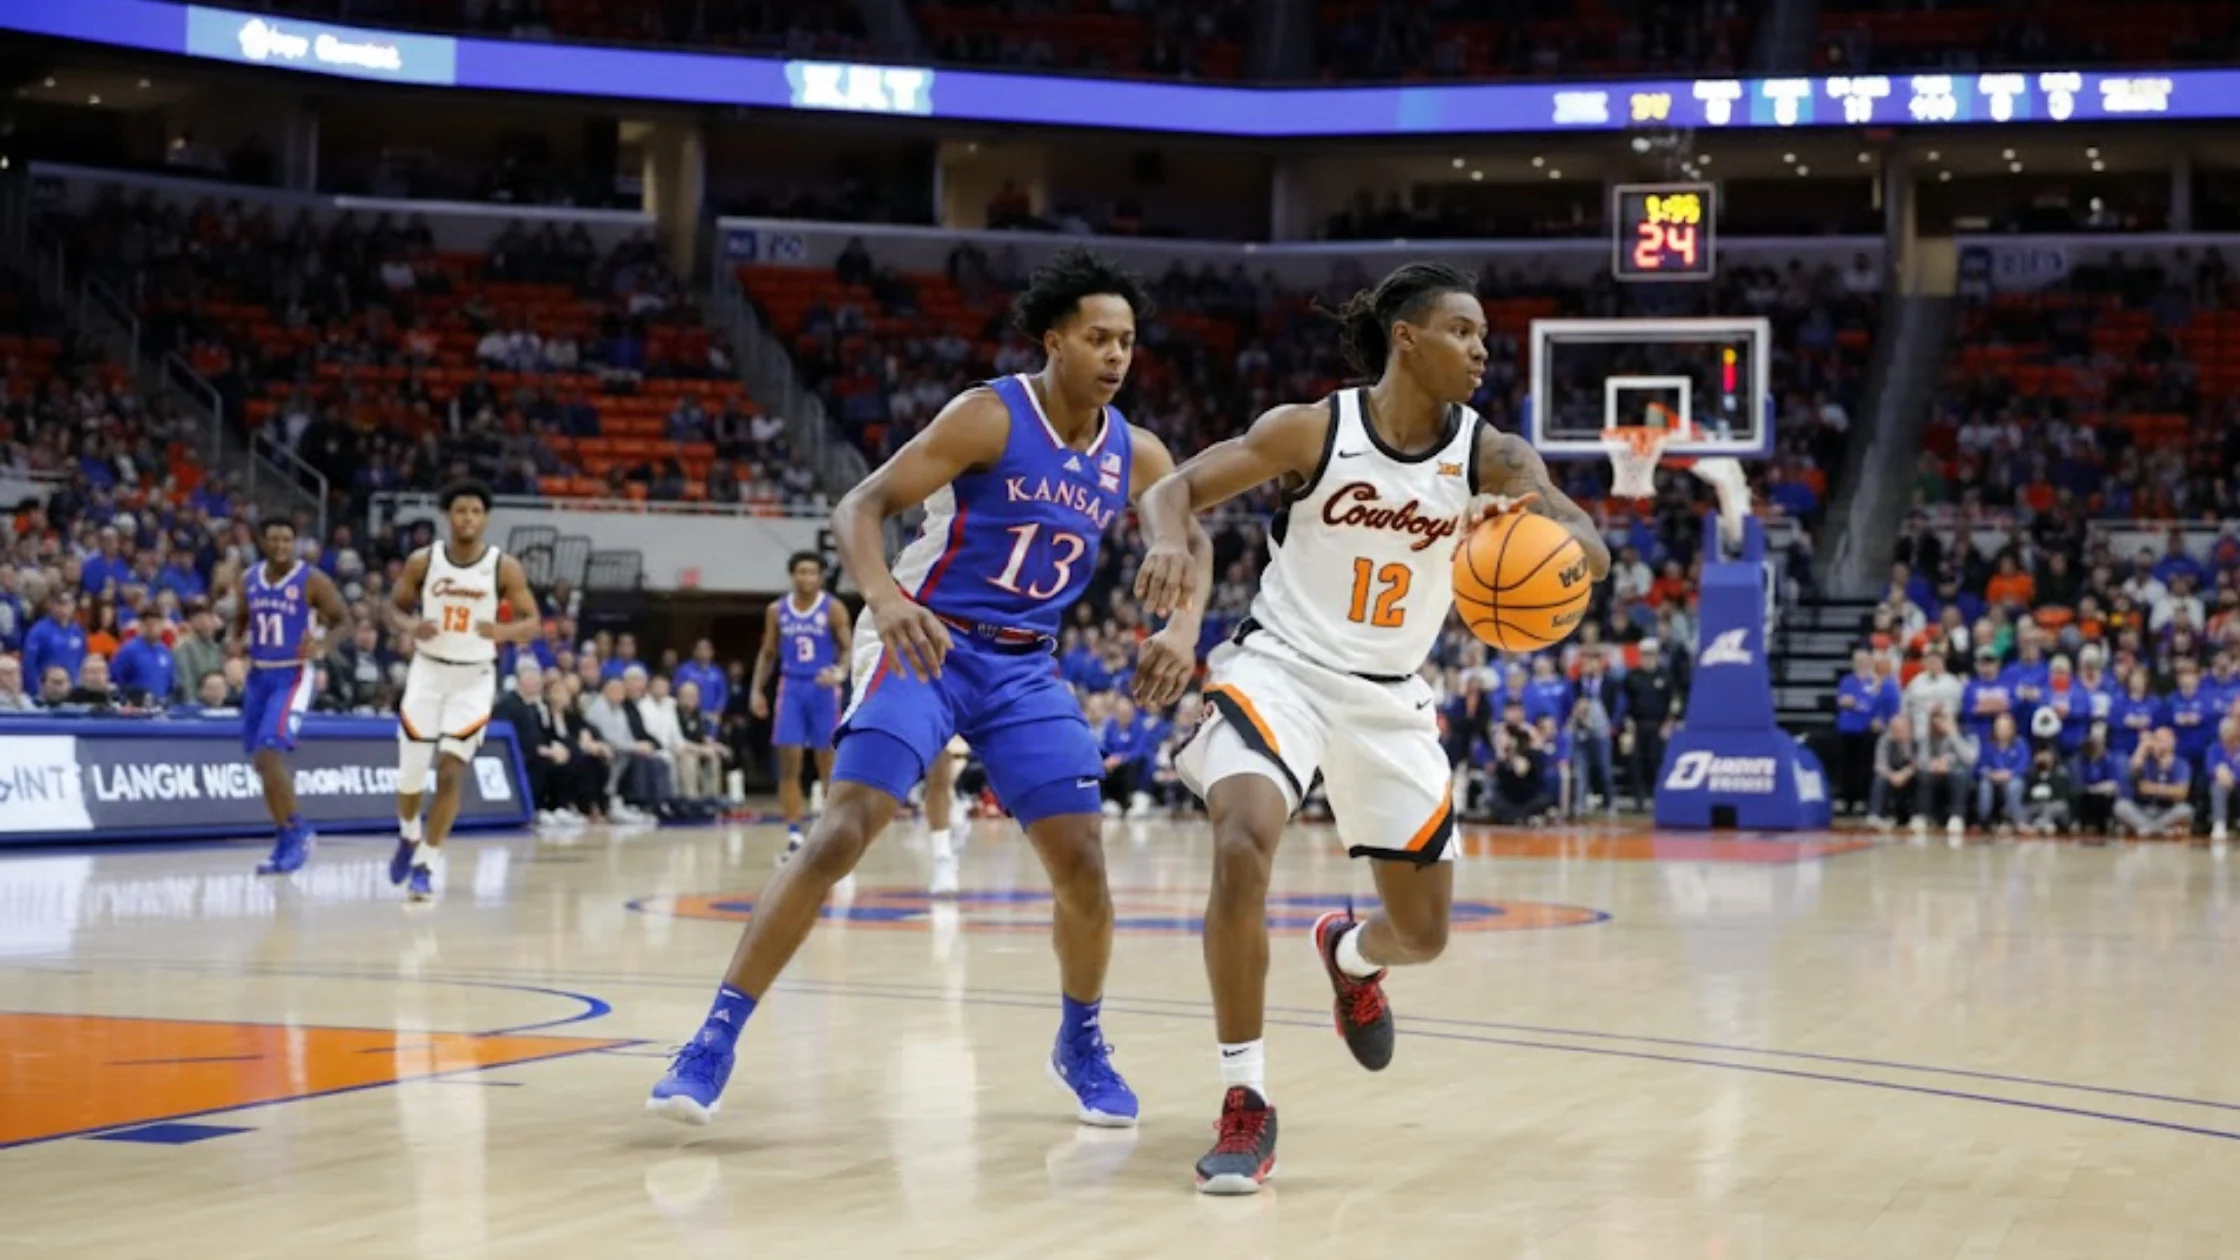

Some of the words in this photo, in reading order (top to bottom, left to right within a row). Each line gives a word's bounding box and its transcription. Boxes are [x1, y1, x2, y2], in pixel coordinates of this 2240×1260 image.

[1634, 222, 1696, 268] 24
[1005, 476, 1116, 530] KANSAS
[1322, 481, 1459, 552] Cowboys
[987, 523, 1086, 600] 13
[1347, 556, 1413, 628] 12
[256, 612, 284, 646] 11
[795, 635, 815, 662] 3
